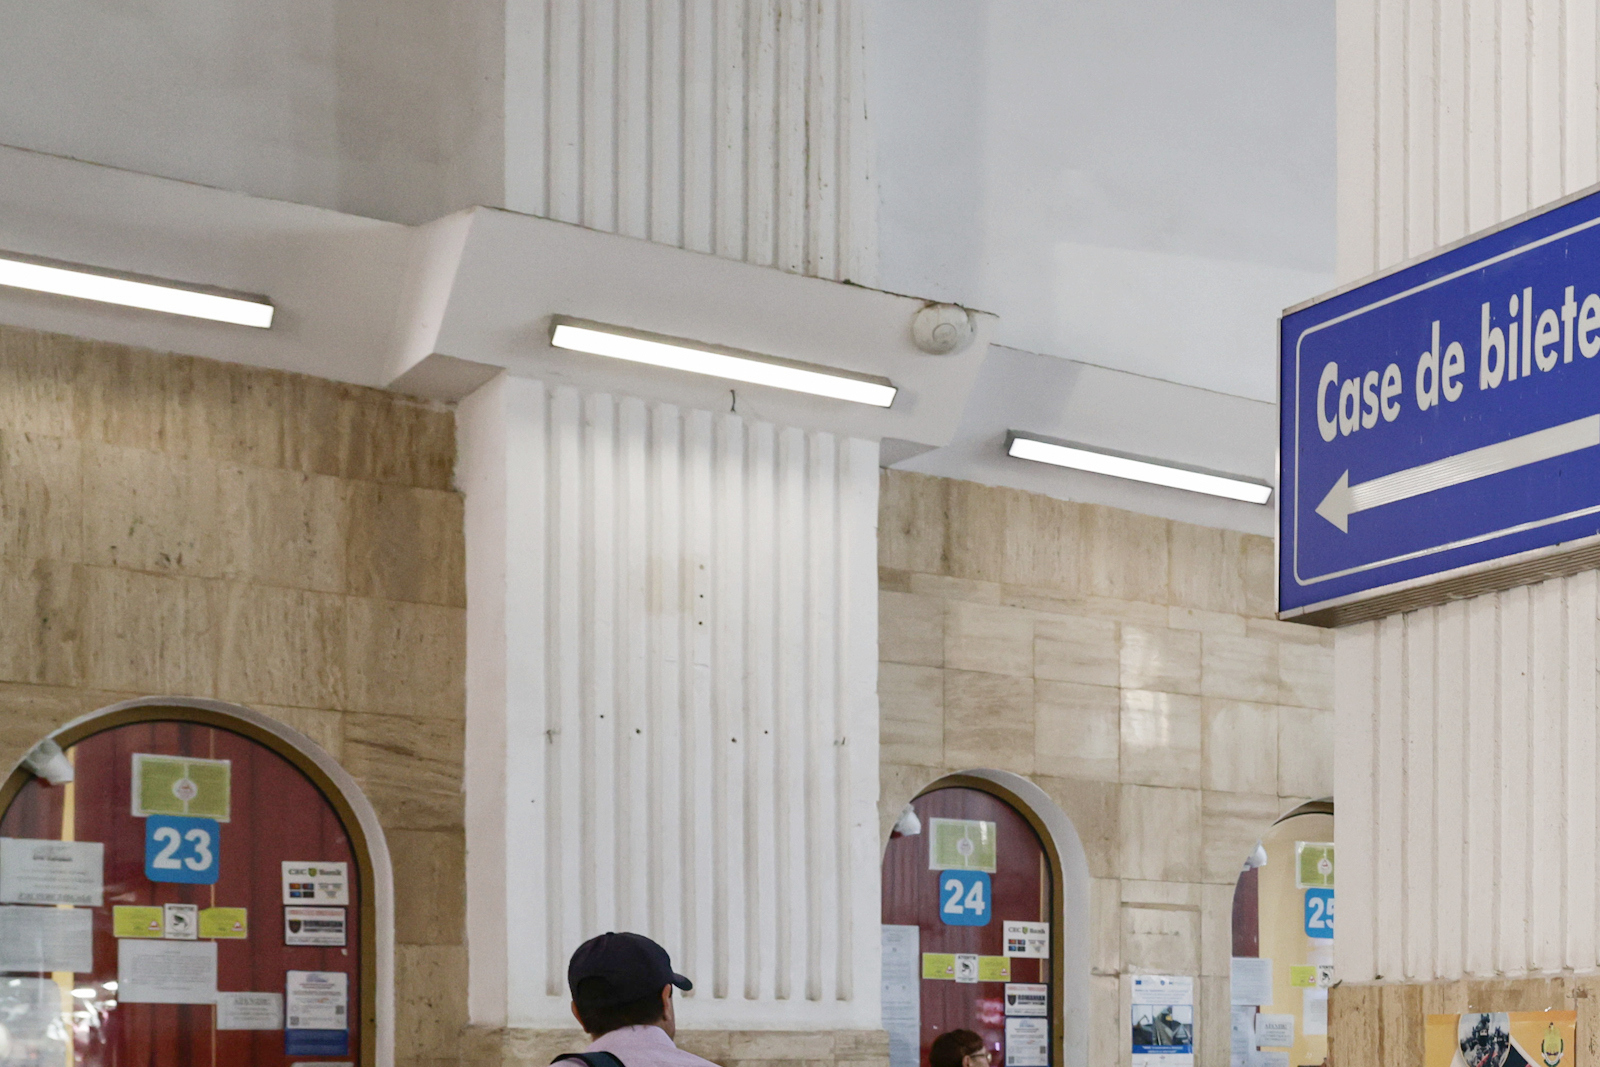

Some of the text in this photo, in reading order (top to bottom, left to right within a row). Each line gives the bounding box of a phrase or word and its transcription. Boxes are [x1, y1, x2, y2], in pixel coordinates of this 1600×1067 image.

[1317, 361, 1402, 442] Case
[1416, 320, 1465, 411] de
[153, 827, 212, 871] 23
[944, 879, 985, 915] 24
